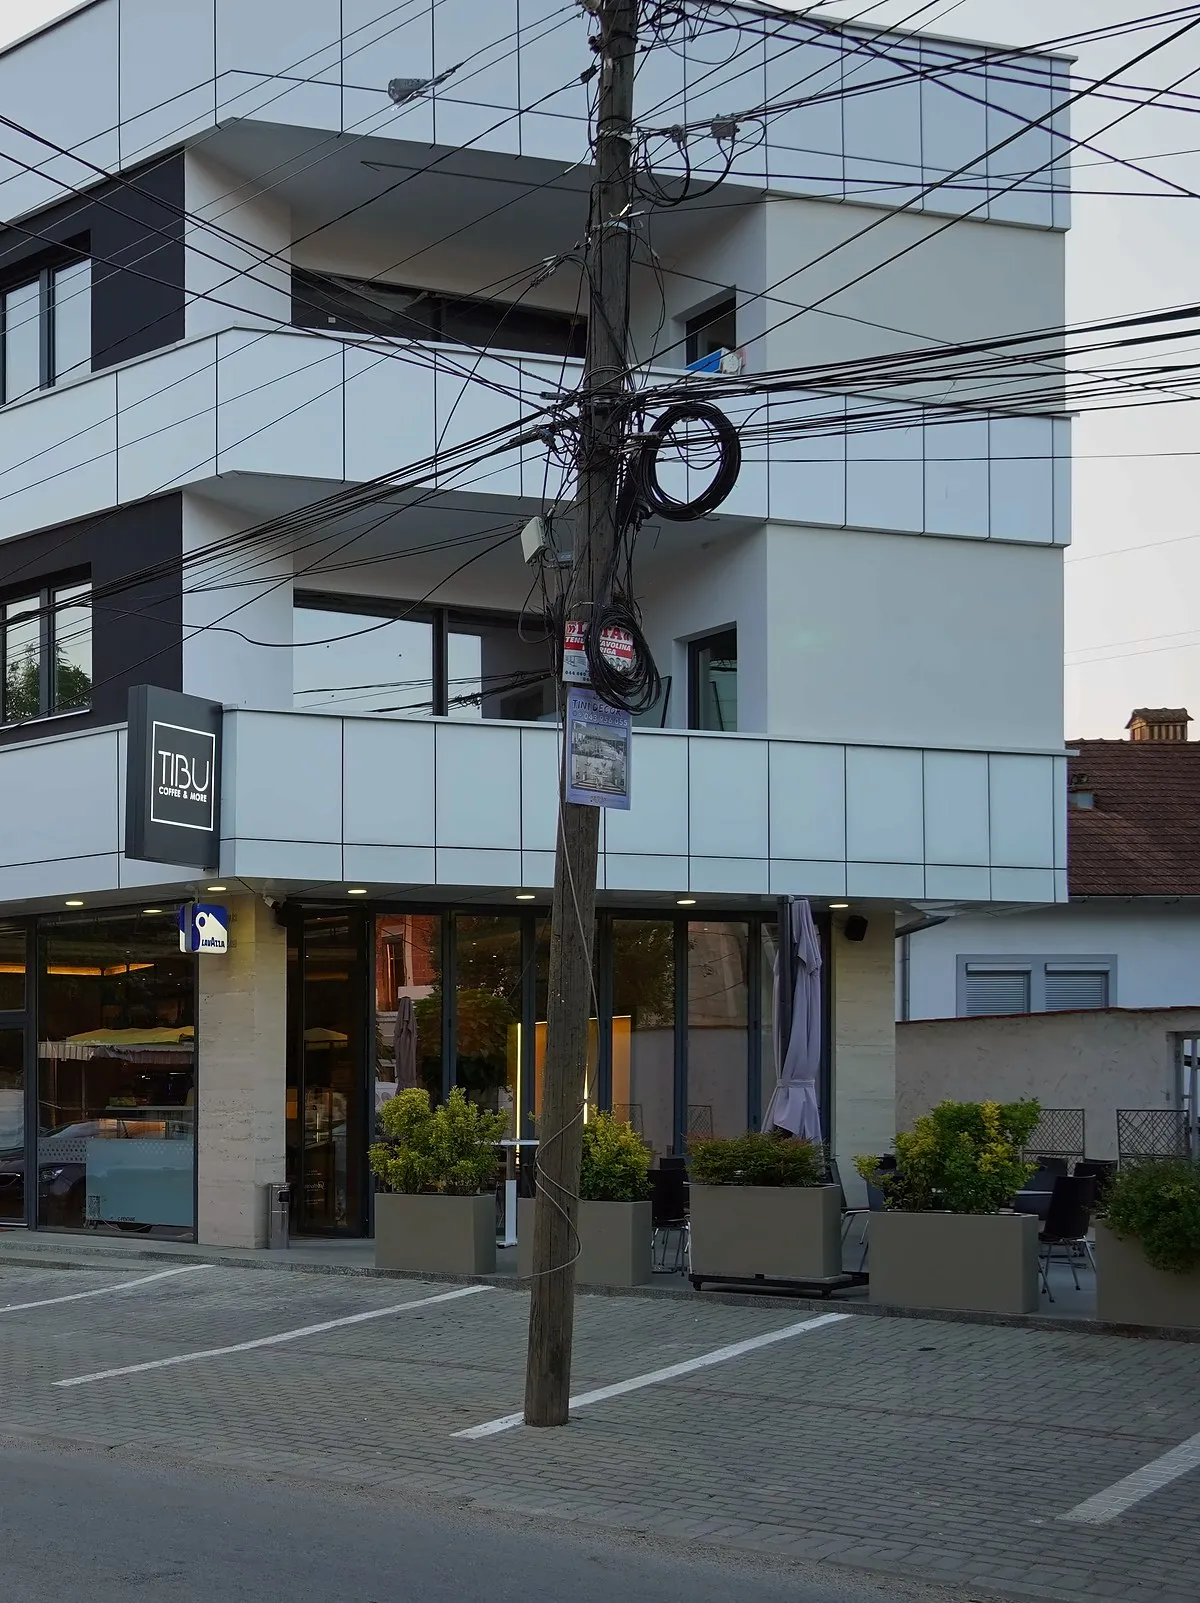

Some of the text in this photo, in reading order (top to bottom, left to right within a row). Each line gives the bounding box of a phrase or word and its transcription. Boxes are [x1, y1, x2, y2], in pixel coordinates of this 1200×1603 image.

[572, 700, 591, 710] TINI
[584, 713, 598, 721] 043
[158, 750, 209, 792] TIBU
[158, 786, 207, 802] COFFEE & MORE
